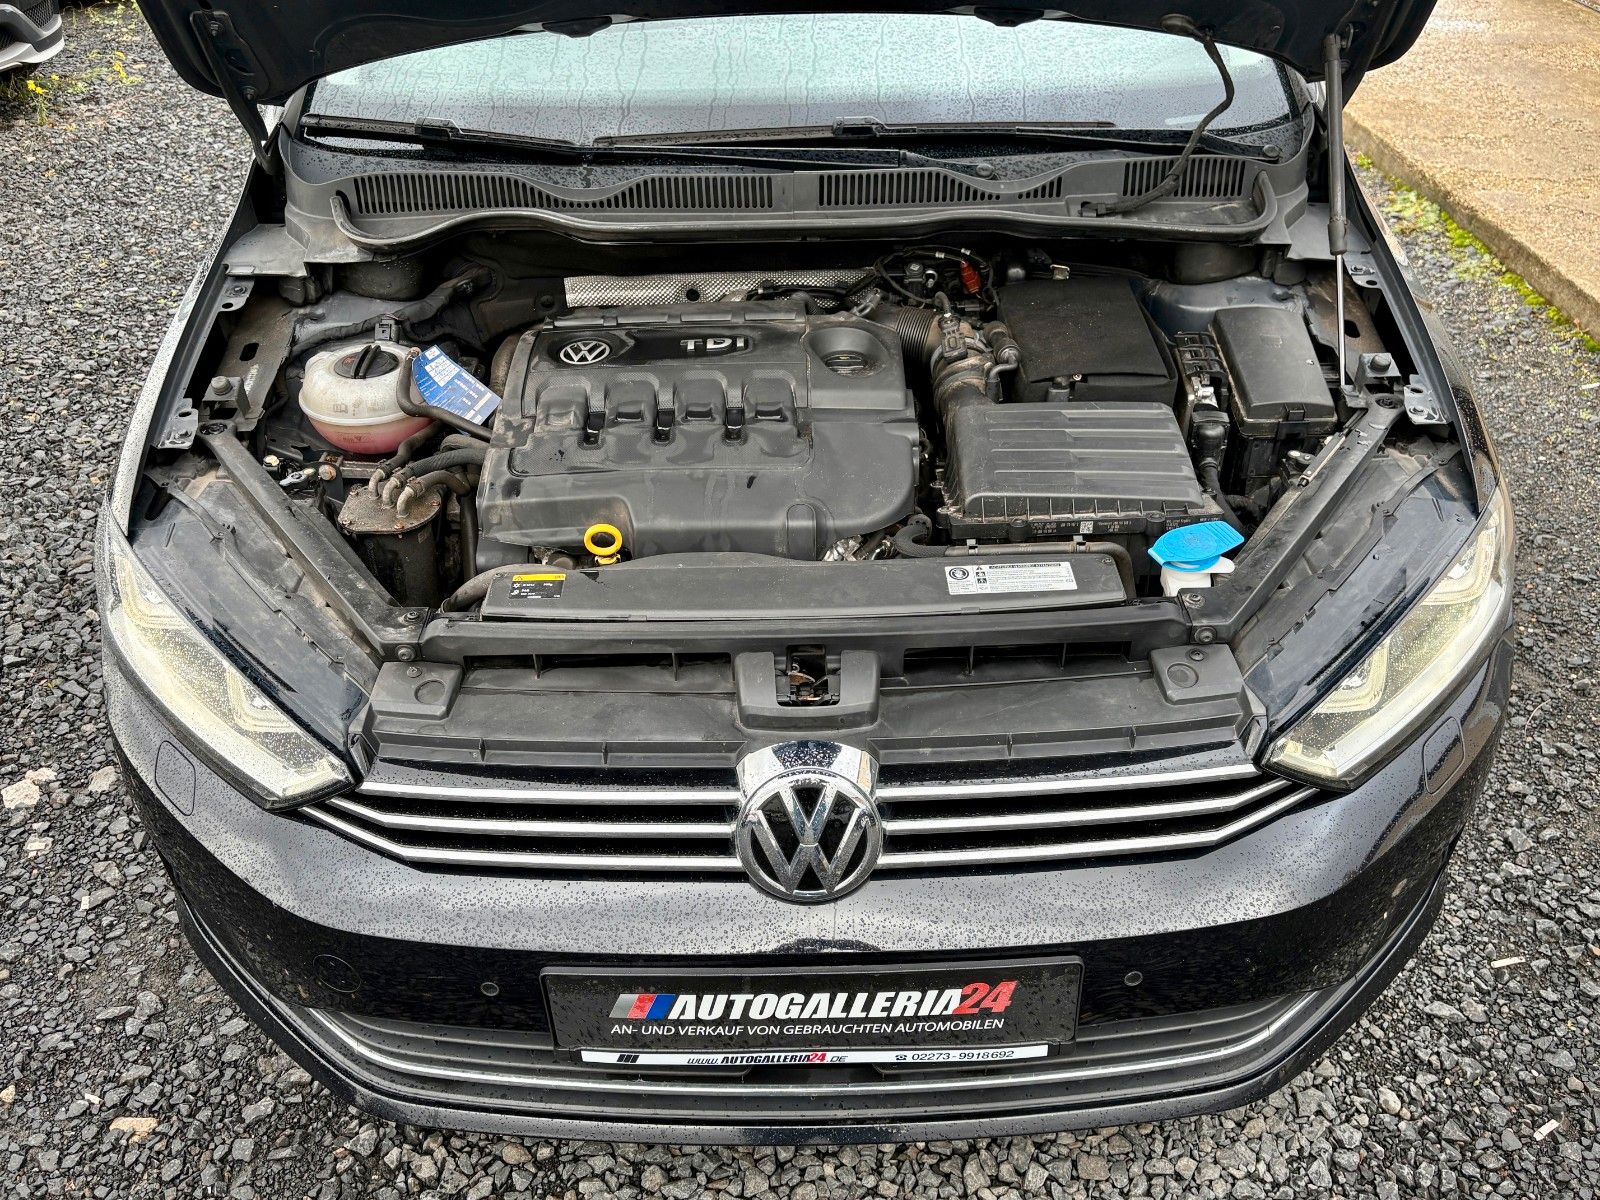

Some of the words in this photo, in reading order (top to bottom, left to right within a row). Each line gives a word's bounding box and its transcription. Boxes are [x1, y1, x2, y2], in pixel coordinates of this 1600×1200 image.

[679, 337, 746, 353] TDI
[667, 979, 1018, 1020] AUTOGALLERIA24
[610, 1024, 638, 1035] AN-
[642, 1025, 675, 1036] UND
[679, 1025, 744, 1036] VERKAUF
[747, 1025, 780, 1035] VON
[783, 1022, 893, 1035] GEBRAUCHTEN
[895, 1018, 1005, 1033] AUTOMOBILEN
